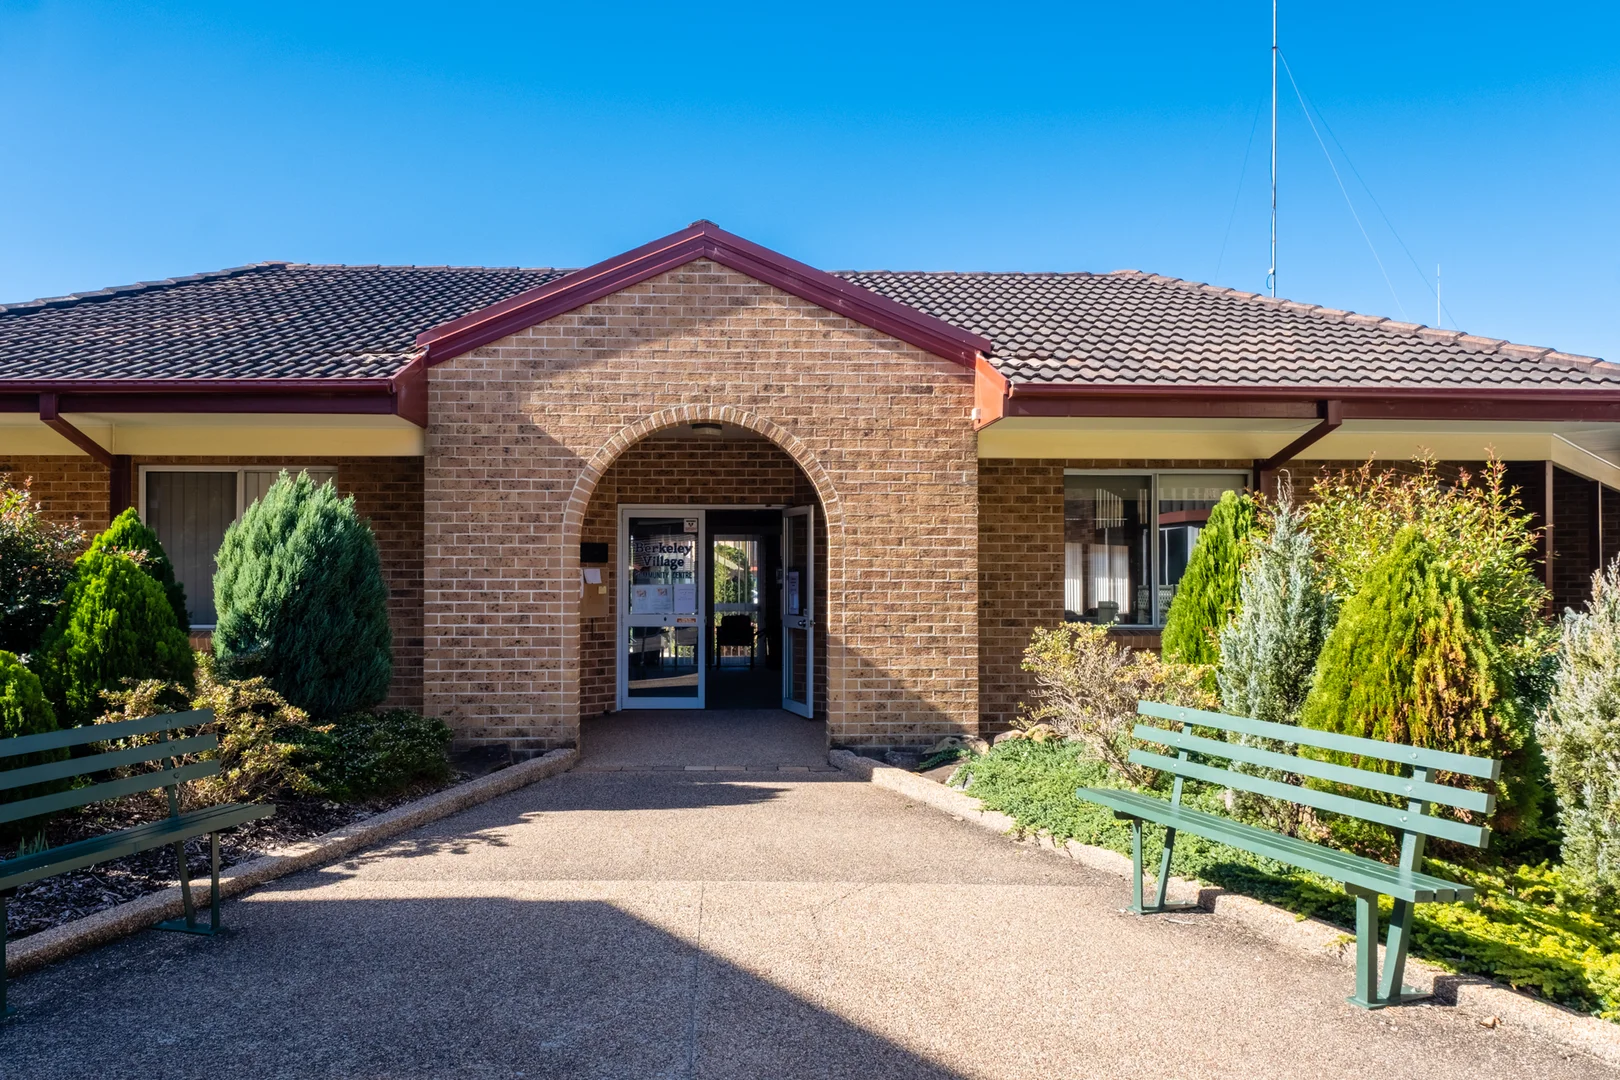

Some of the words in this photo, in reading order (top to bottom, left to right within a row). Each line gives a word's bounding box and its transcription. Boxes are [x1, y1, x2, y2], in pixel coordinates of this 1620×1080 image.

[635, 542, 693, 556] Berkeley
[642, 555, 684, 570] Village
[636, 571, 669, 579] OMMUNITY
[672, 571, 692, 579] CENTRE
